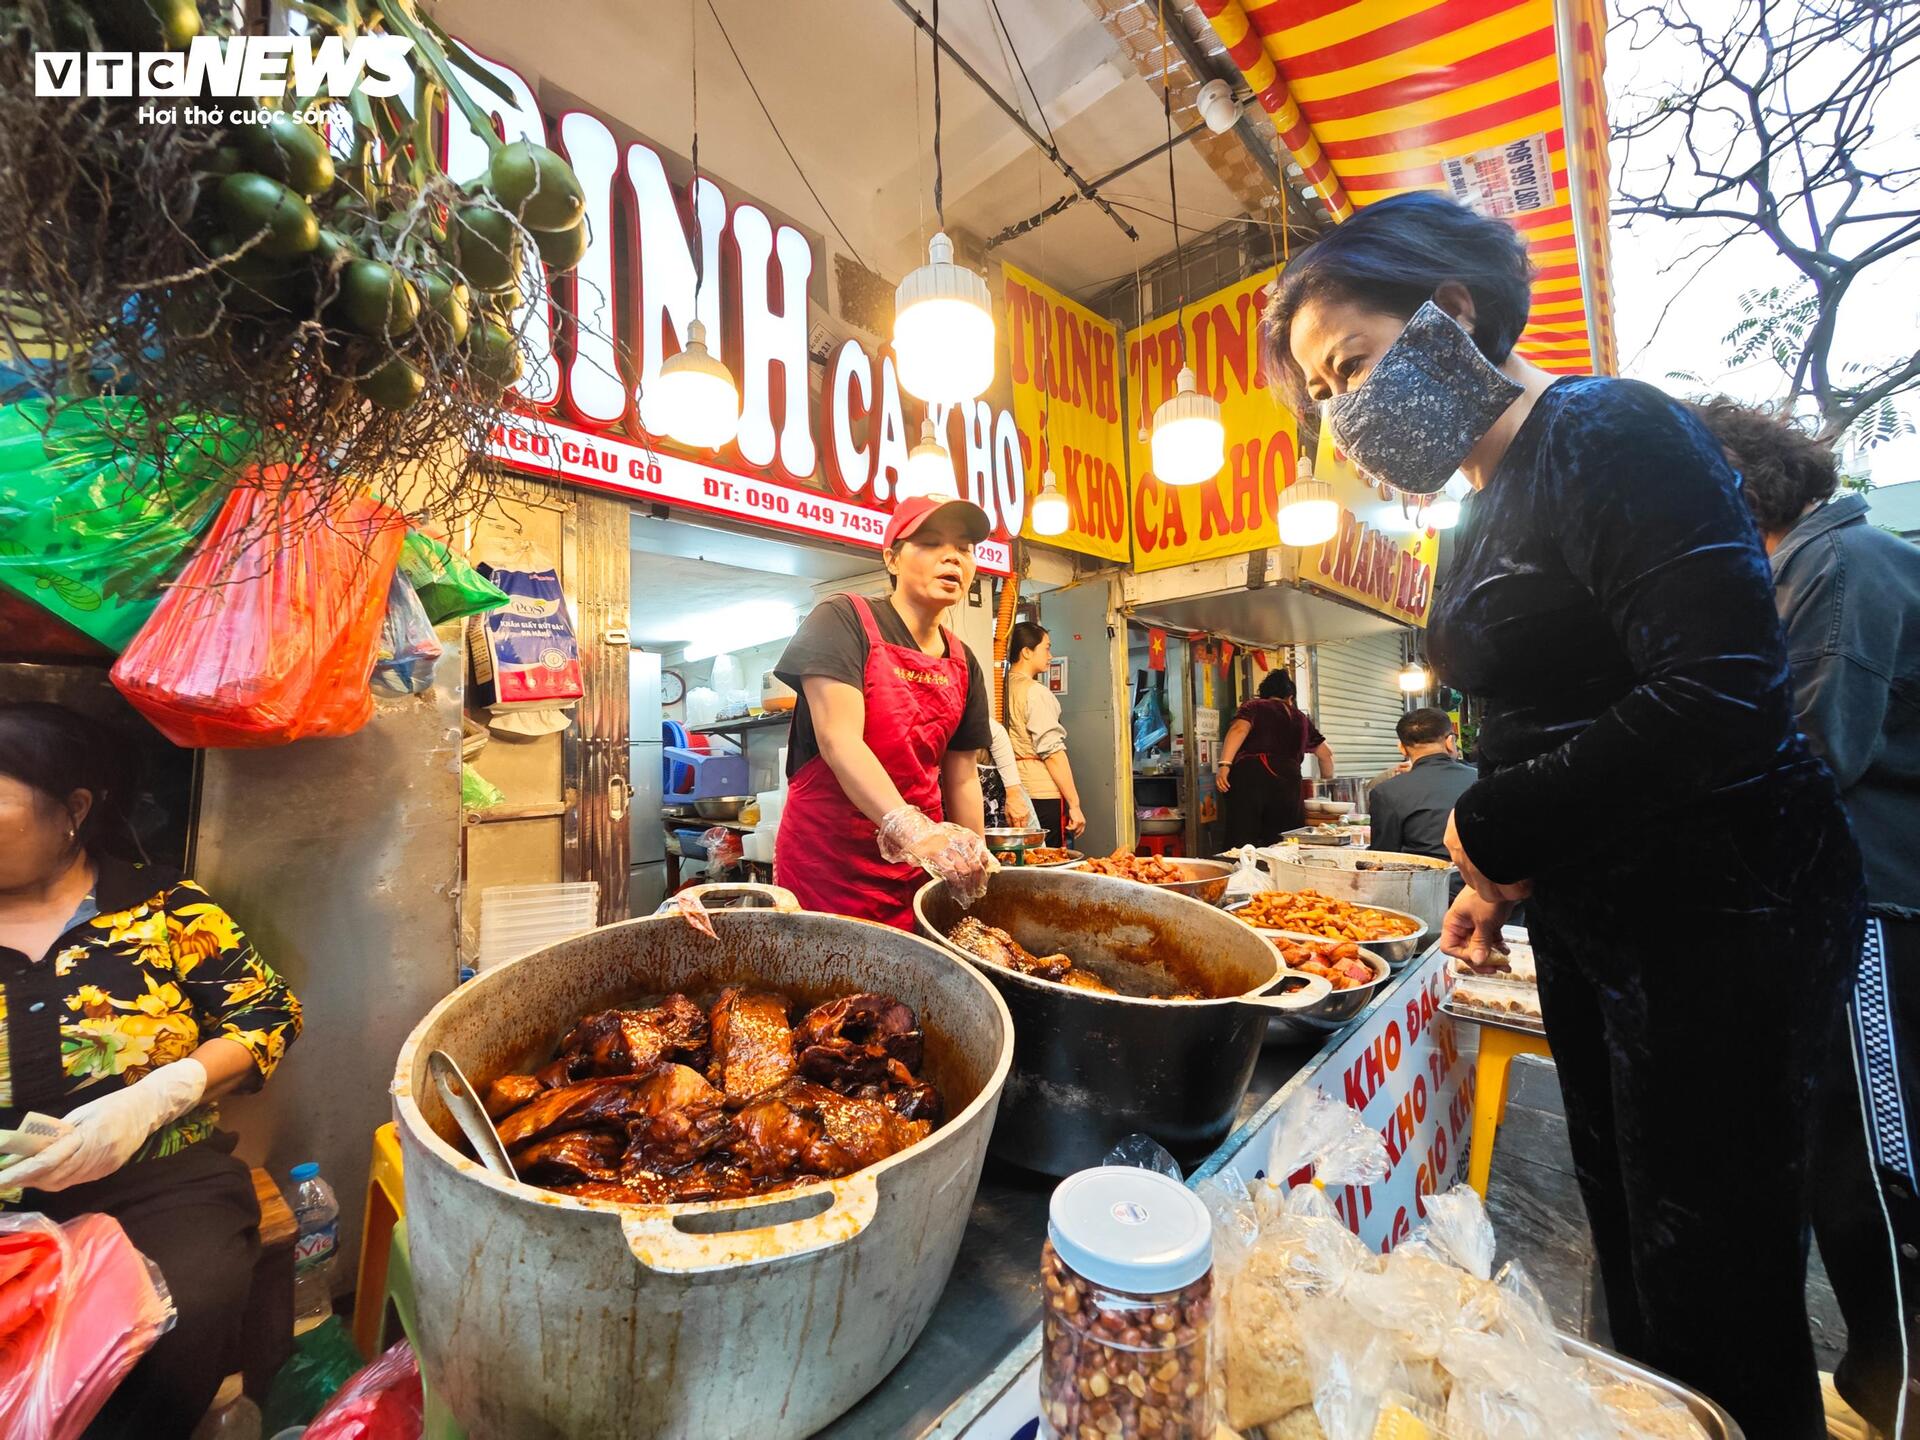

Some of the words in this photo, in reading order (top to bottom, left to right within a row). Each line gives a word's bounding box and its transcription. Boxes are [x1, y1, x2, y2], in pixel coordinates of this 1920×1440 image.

[1005, 277, 1118, 424] TRINH
[561, 437, 618, 474] CẦU
[628, 456, 662, 484] GỖ
[703, 477, 739, 502] ĐT:
[746, 488, 789, 514] 090
[796, 501, 834, 525] 449
[840, 511, 884, 536] 7435
[1063, 445, 1124, 543] KHO
[1343, 1019, 1401, 1112] KHO
[1406, 973, 1440, 1046] ĐẶC
[1381, 1073, 1427, 1168] KHO
[1415, 1120, 1447, 1218] GIÒ
